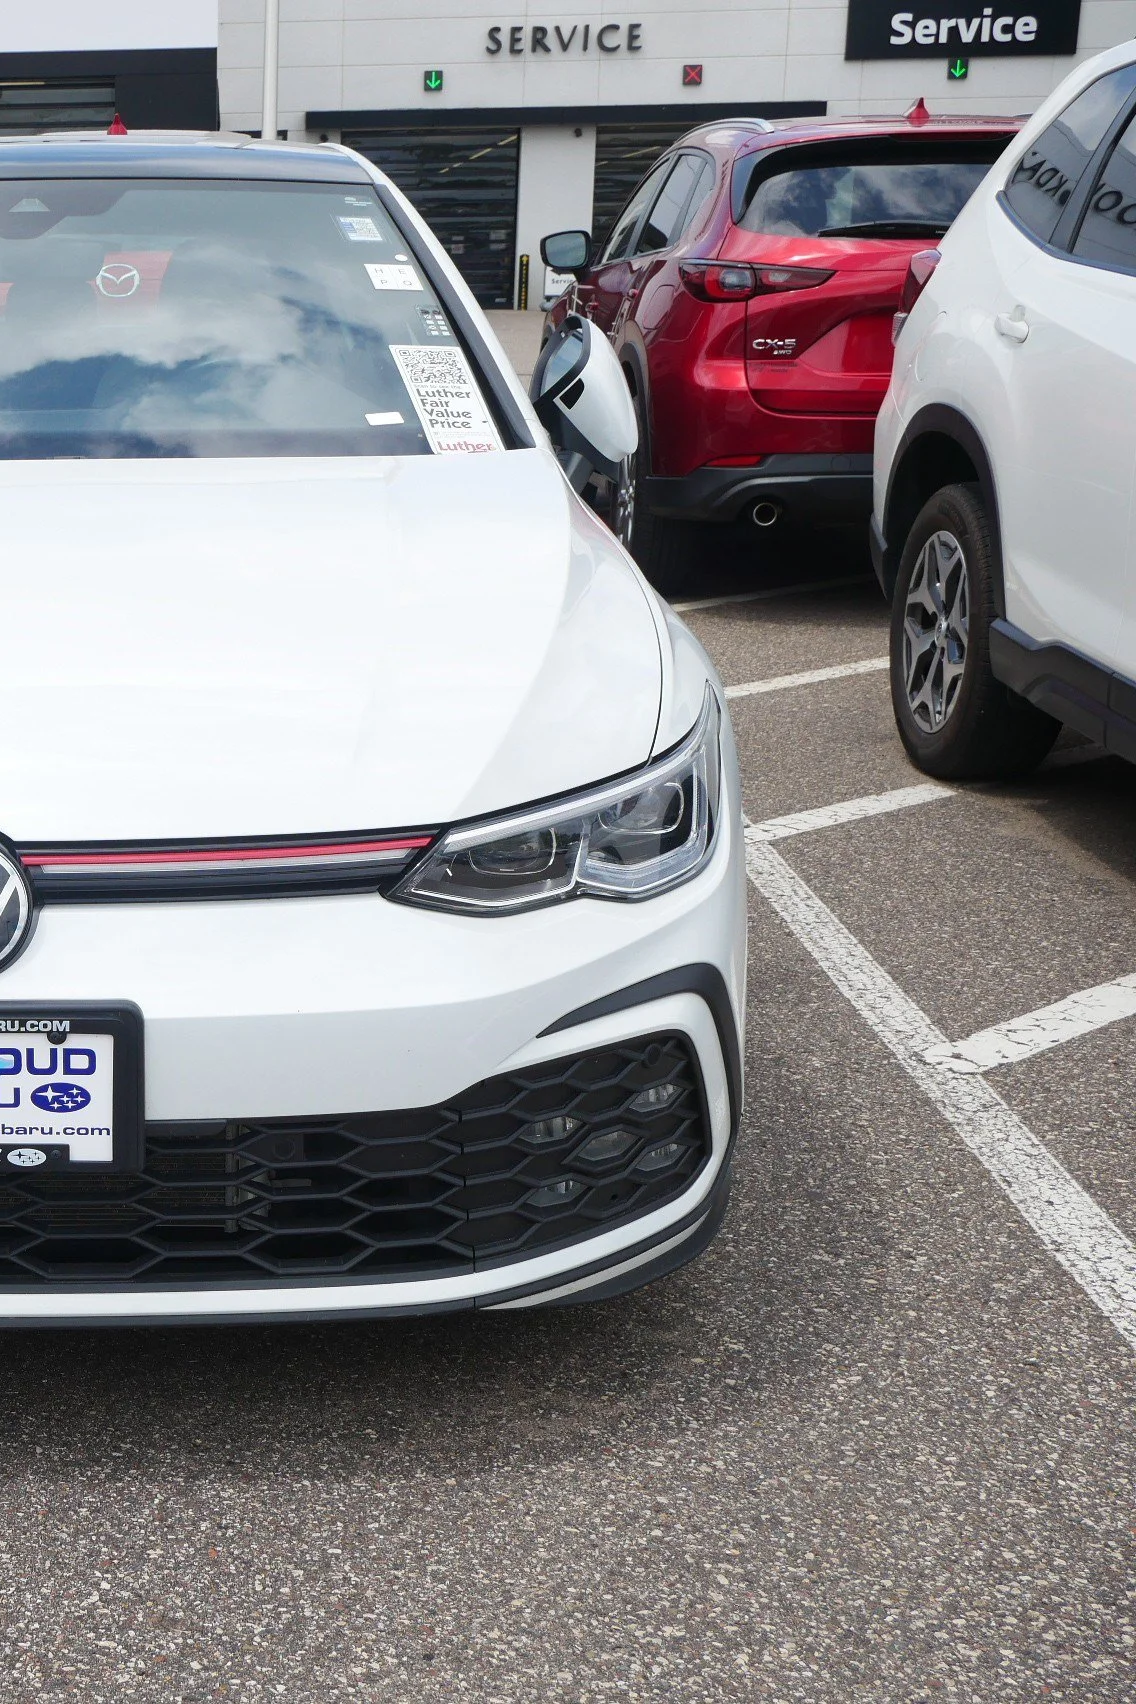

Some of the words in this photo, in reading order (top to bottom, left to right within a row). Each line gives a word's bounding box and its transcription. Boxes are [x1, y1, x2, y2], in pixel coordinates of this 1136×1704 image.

[889, 7, 1038, 45] Service
[485, 23, 643, 55] SERVICE
[752, 338, 797, 350] CX-5
[416, 388, 471, 399] Luther
[420, 398, 450, 408] Fair
[423, 408, 472, 419] Value
[428, 418, 472, 429] Price
[437, 441, 495, 454] Luther
